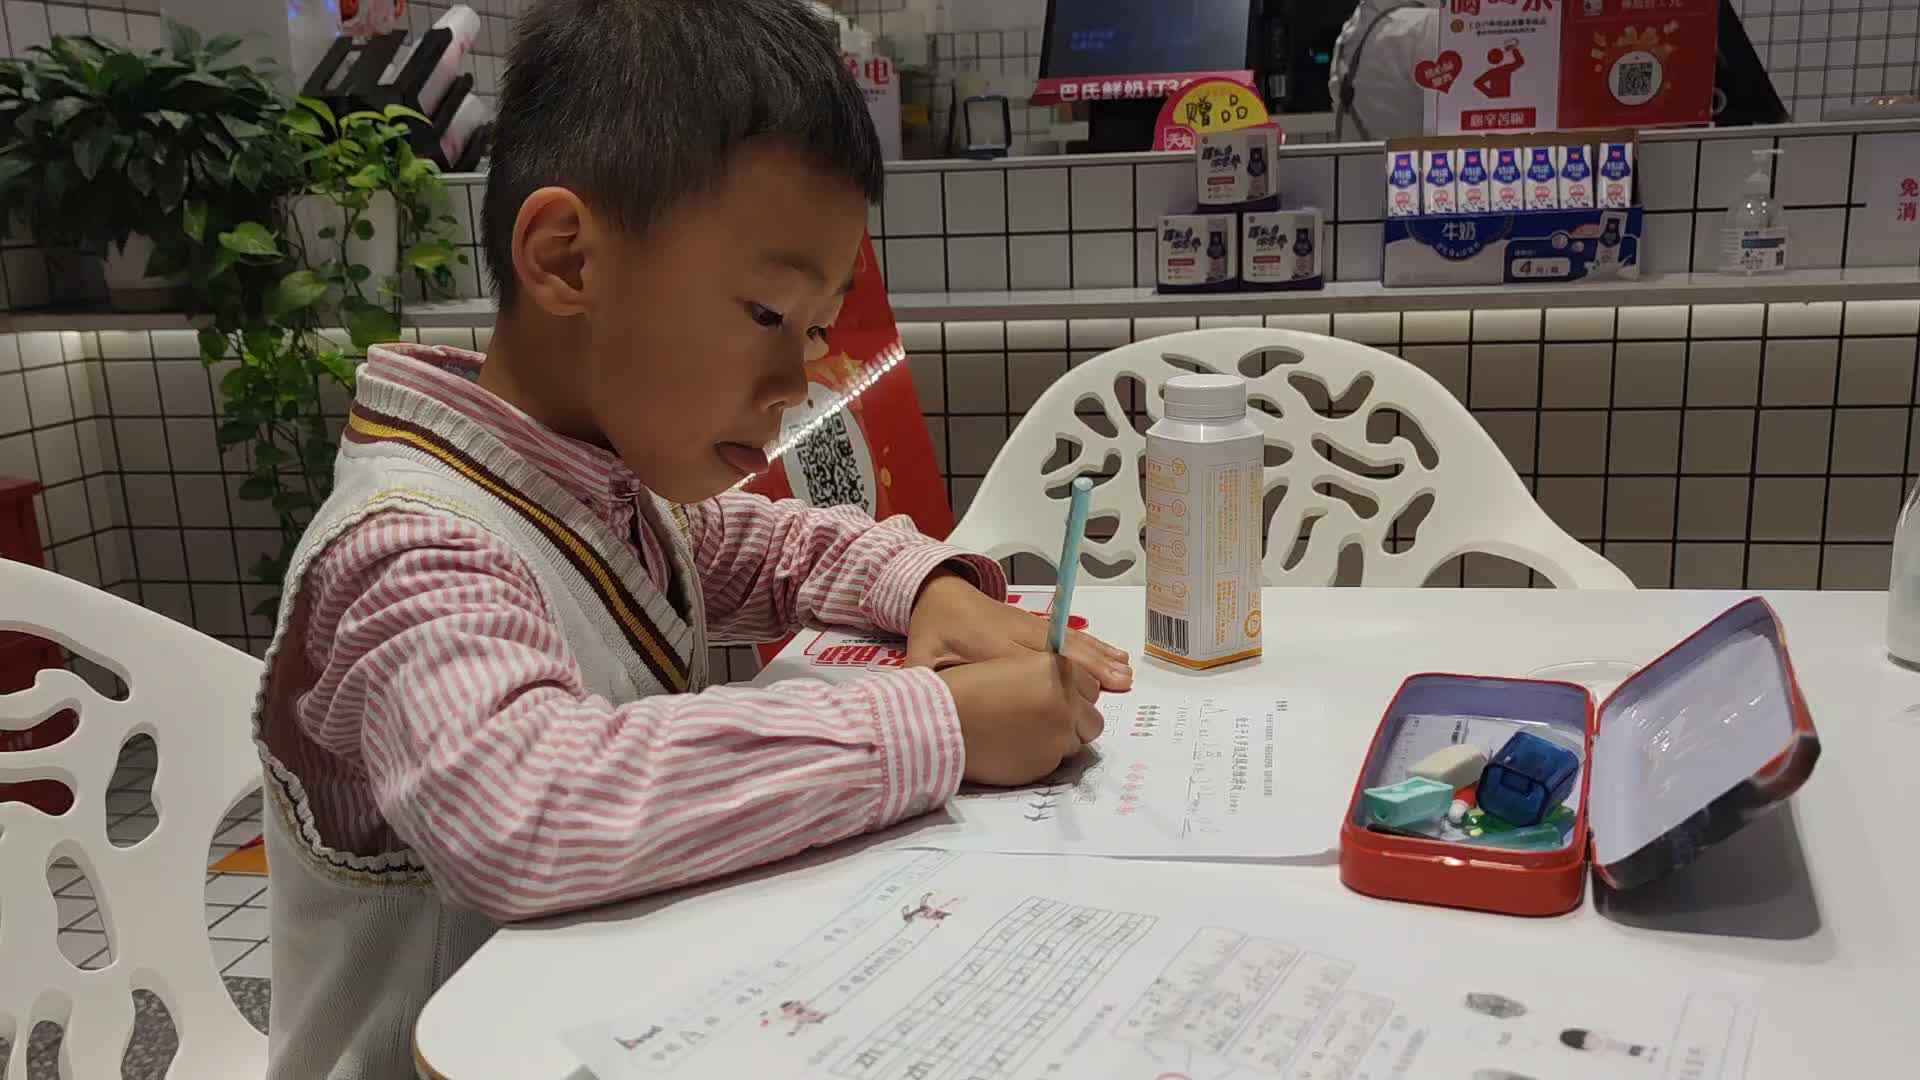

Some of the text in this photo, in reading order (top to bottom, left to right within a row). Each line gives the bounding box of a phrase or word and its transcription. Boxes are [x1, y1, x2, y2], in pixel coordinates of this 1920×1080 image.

[1185, 94, 1248, 126] 赠品
[1899, 177, 1919, 197] 免
[1896, 202, 1917, 221] 消
[1441, 221, 1477, 241] 牛奶
